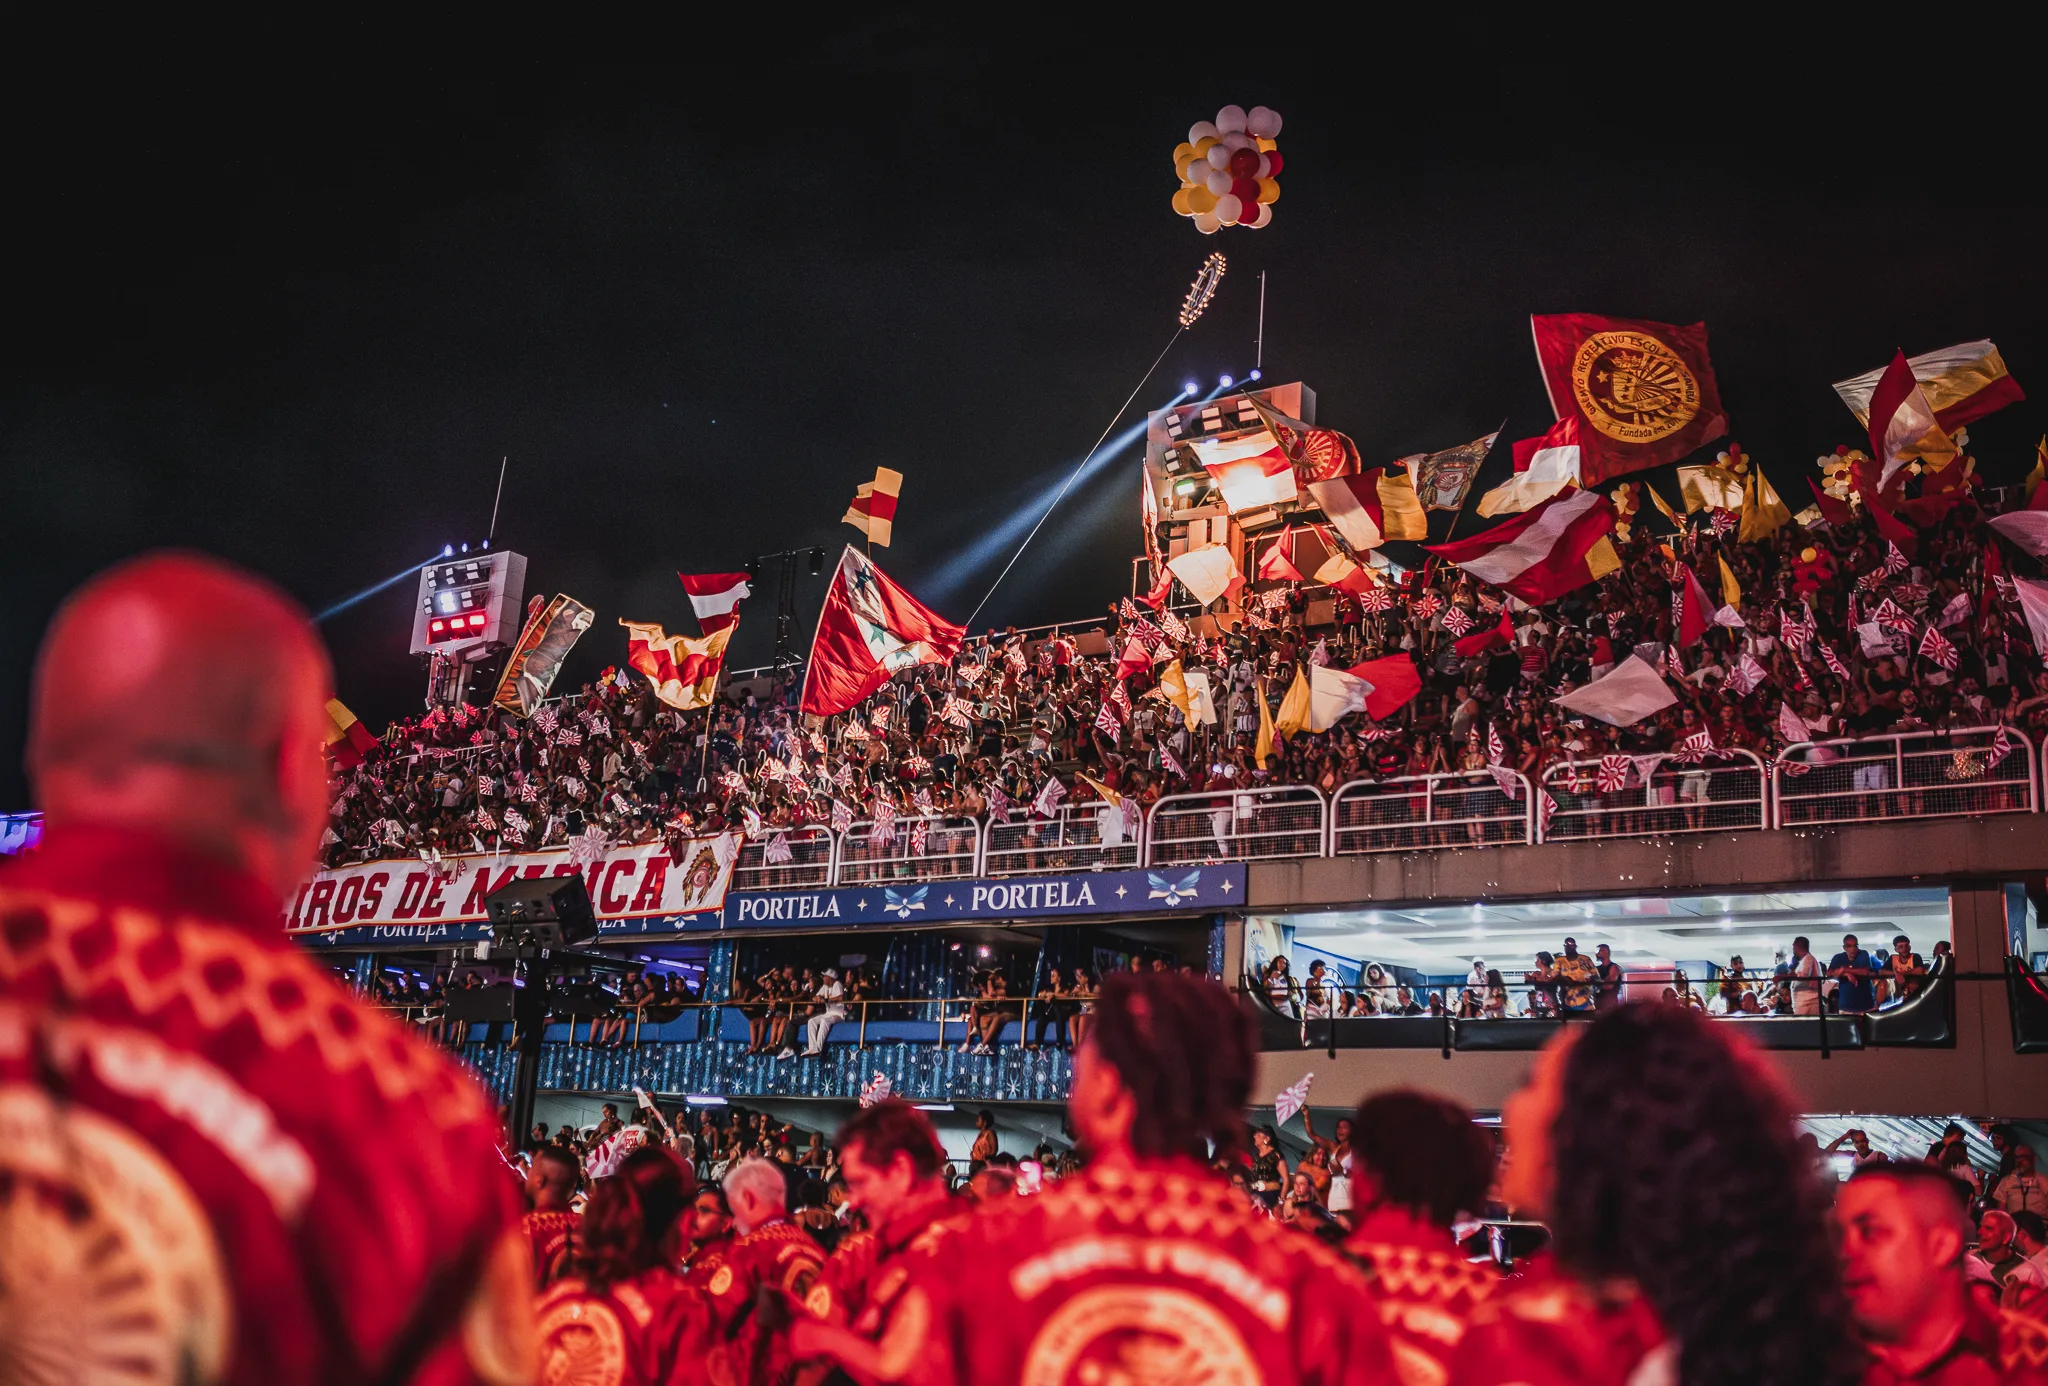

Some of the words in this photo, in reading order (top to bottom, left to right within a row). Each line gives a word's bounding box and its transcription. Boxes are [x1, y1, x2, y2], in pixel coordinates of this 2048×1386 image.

[1618, 425, 1653, 438] Fundada
[284, 873, 390, 928] IROS
[391, 871, 453, 919] DE
[738, 895, 841, 921] PORTELA
[971, 881, 1096, 911] PORTELA
